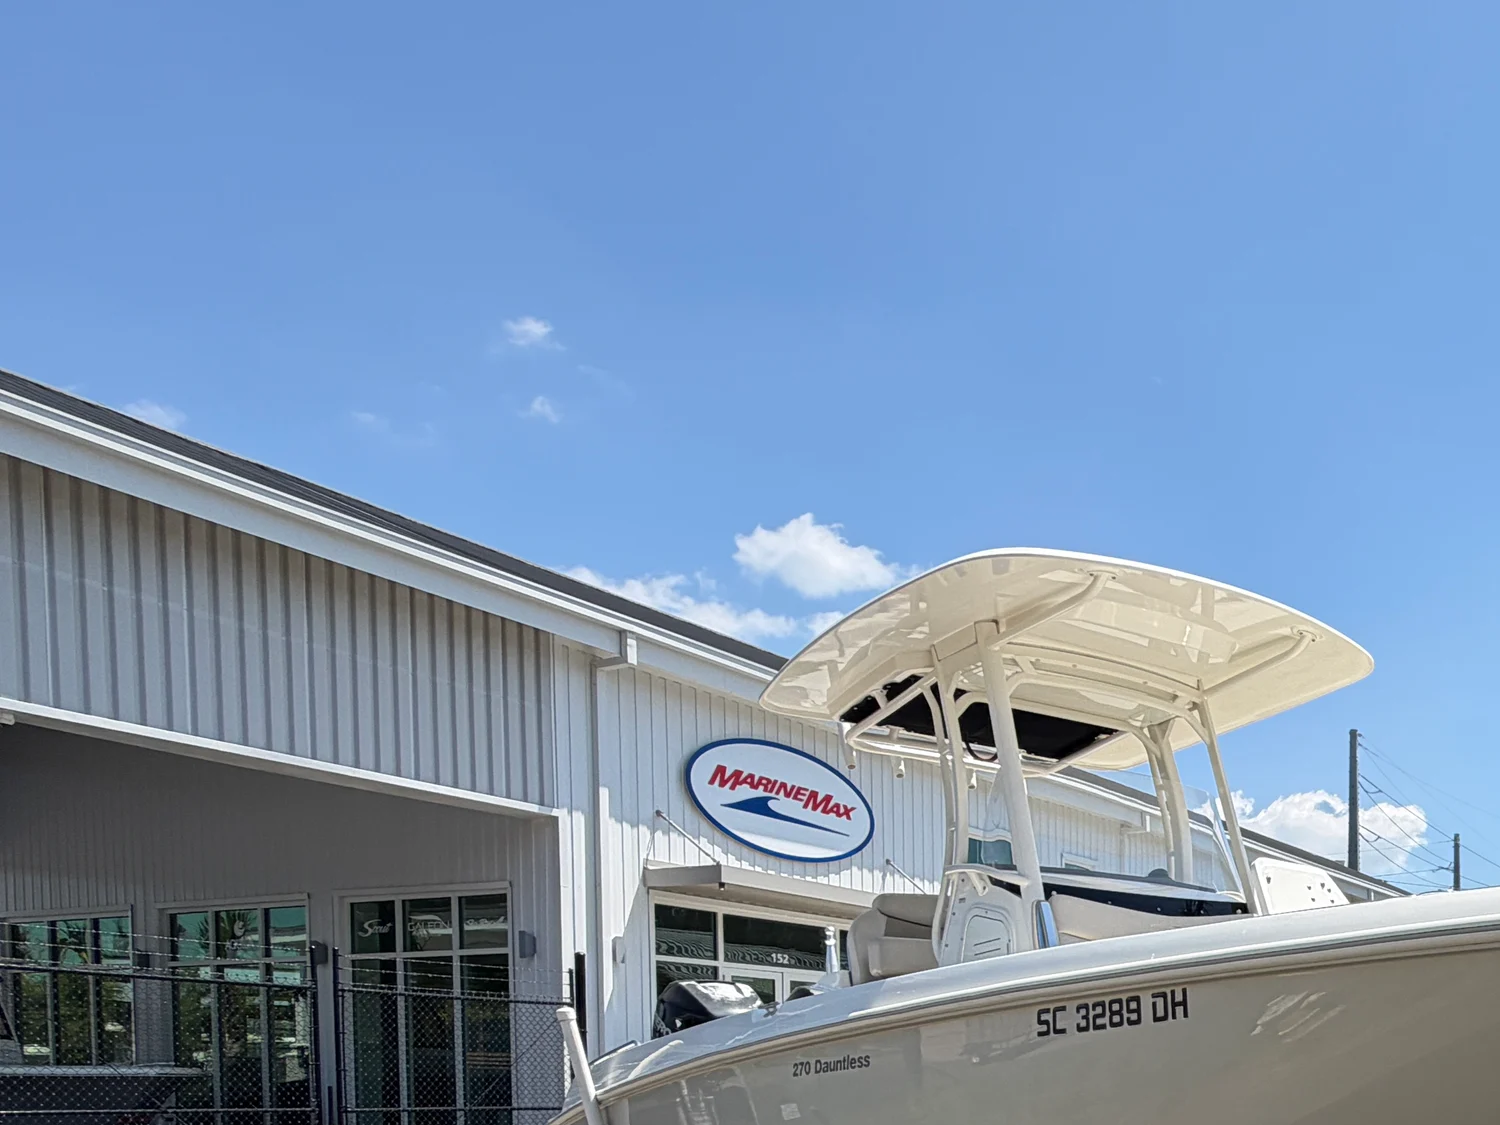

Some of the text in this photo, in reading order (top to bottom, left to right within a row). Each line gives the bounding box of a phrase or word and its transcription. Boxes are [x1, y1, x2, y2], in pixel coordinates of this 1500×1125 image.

[770, 953, 790, 965] 152
[1036, 987, 1189, 1037] SC 3289 DH
[792, 1054, 871, 1078] 270 Dauntless
